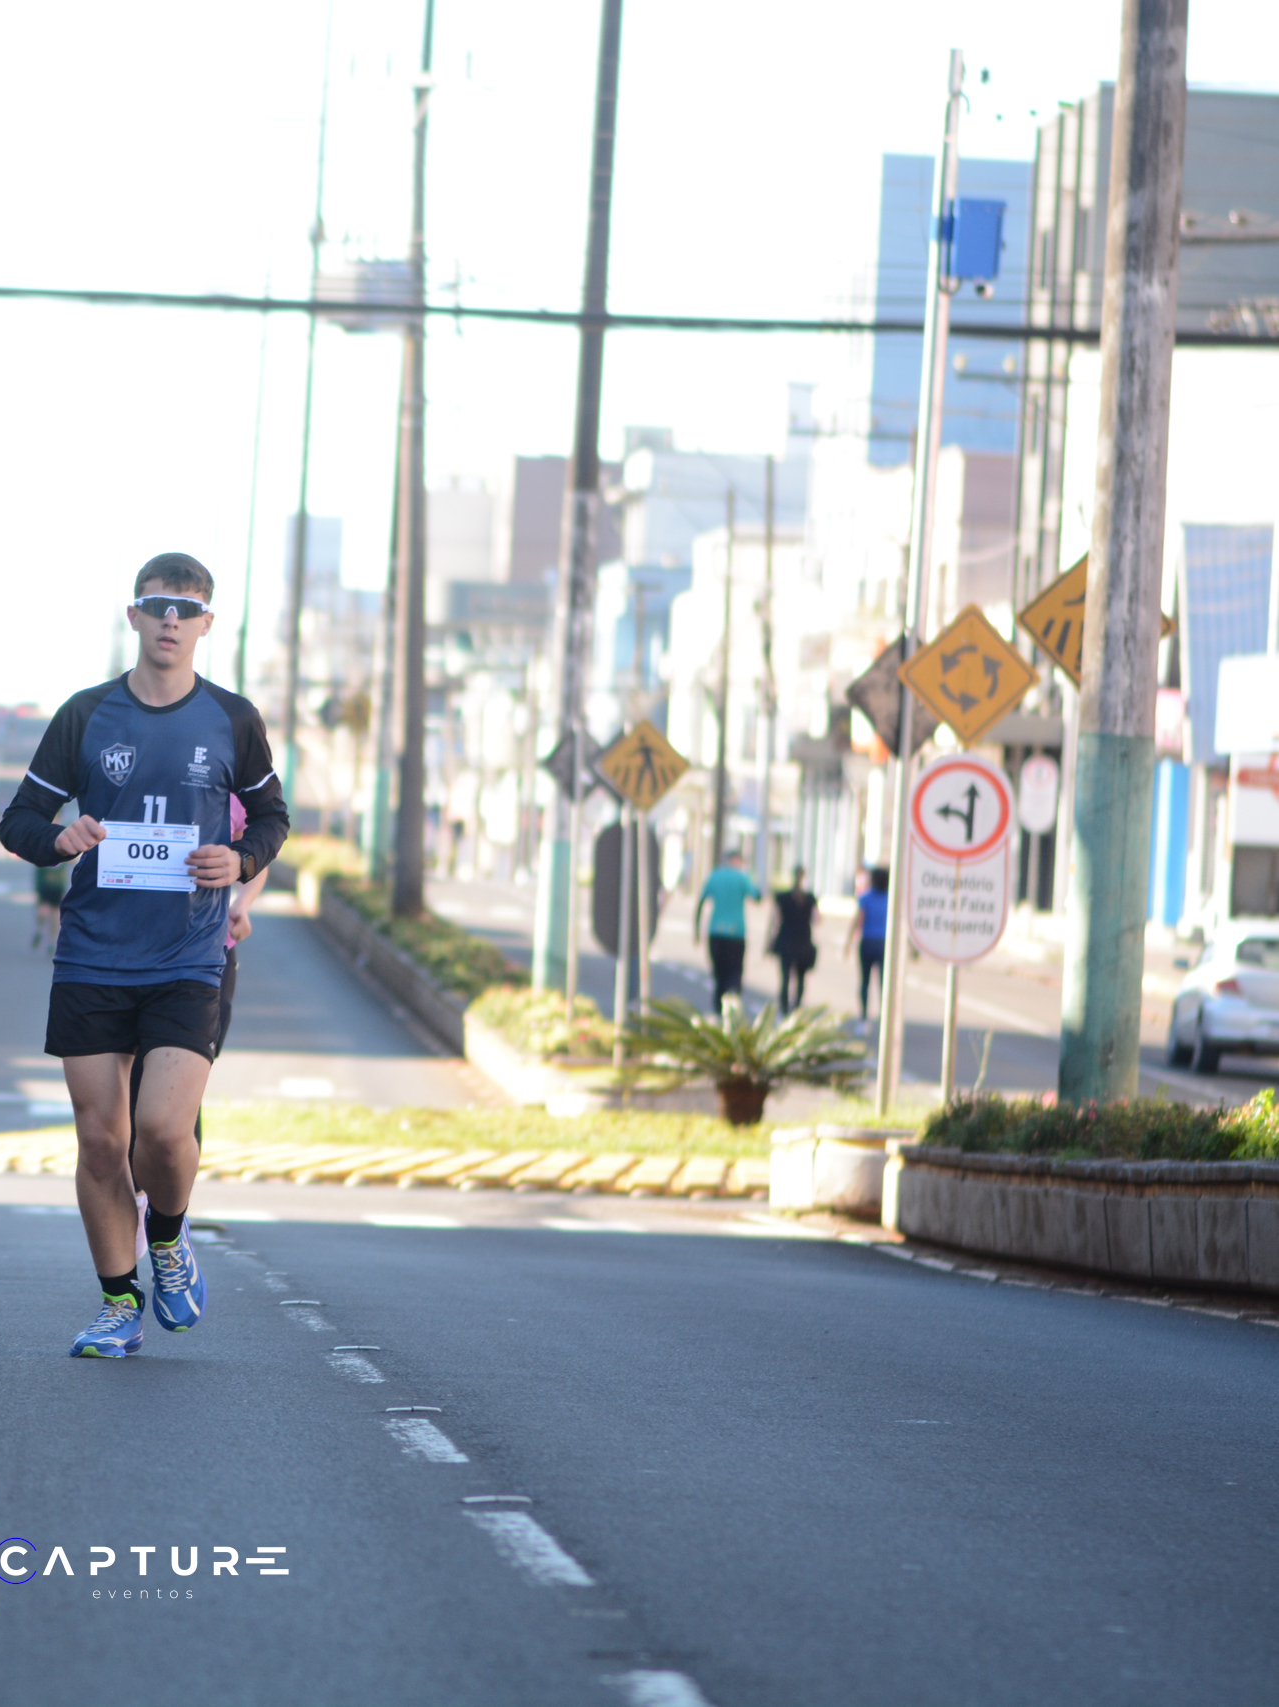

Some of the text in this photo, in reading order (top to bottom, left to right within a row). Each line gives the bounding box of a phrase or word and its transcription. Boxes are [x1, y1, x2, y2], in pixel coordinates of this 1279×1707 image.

[105, 752, 132, 772] MKT
[143, 795, 167, 824] 11
[127, 843, 169, 860] 008
[921, 872, 994, 892] Obrigatório
[917, 896, 946, 911] para
[960, 896, 995, 913] Faixa
[915, 915, 995, 936] da Esquerda
